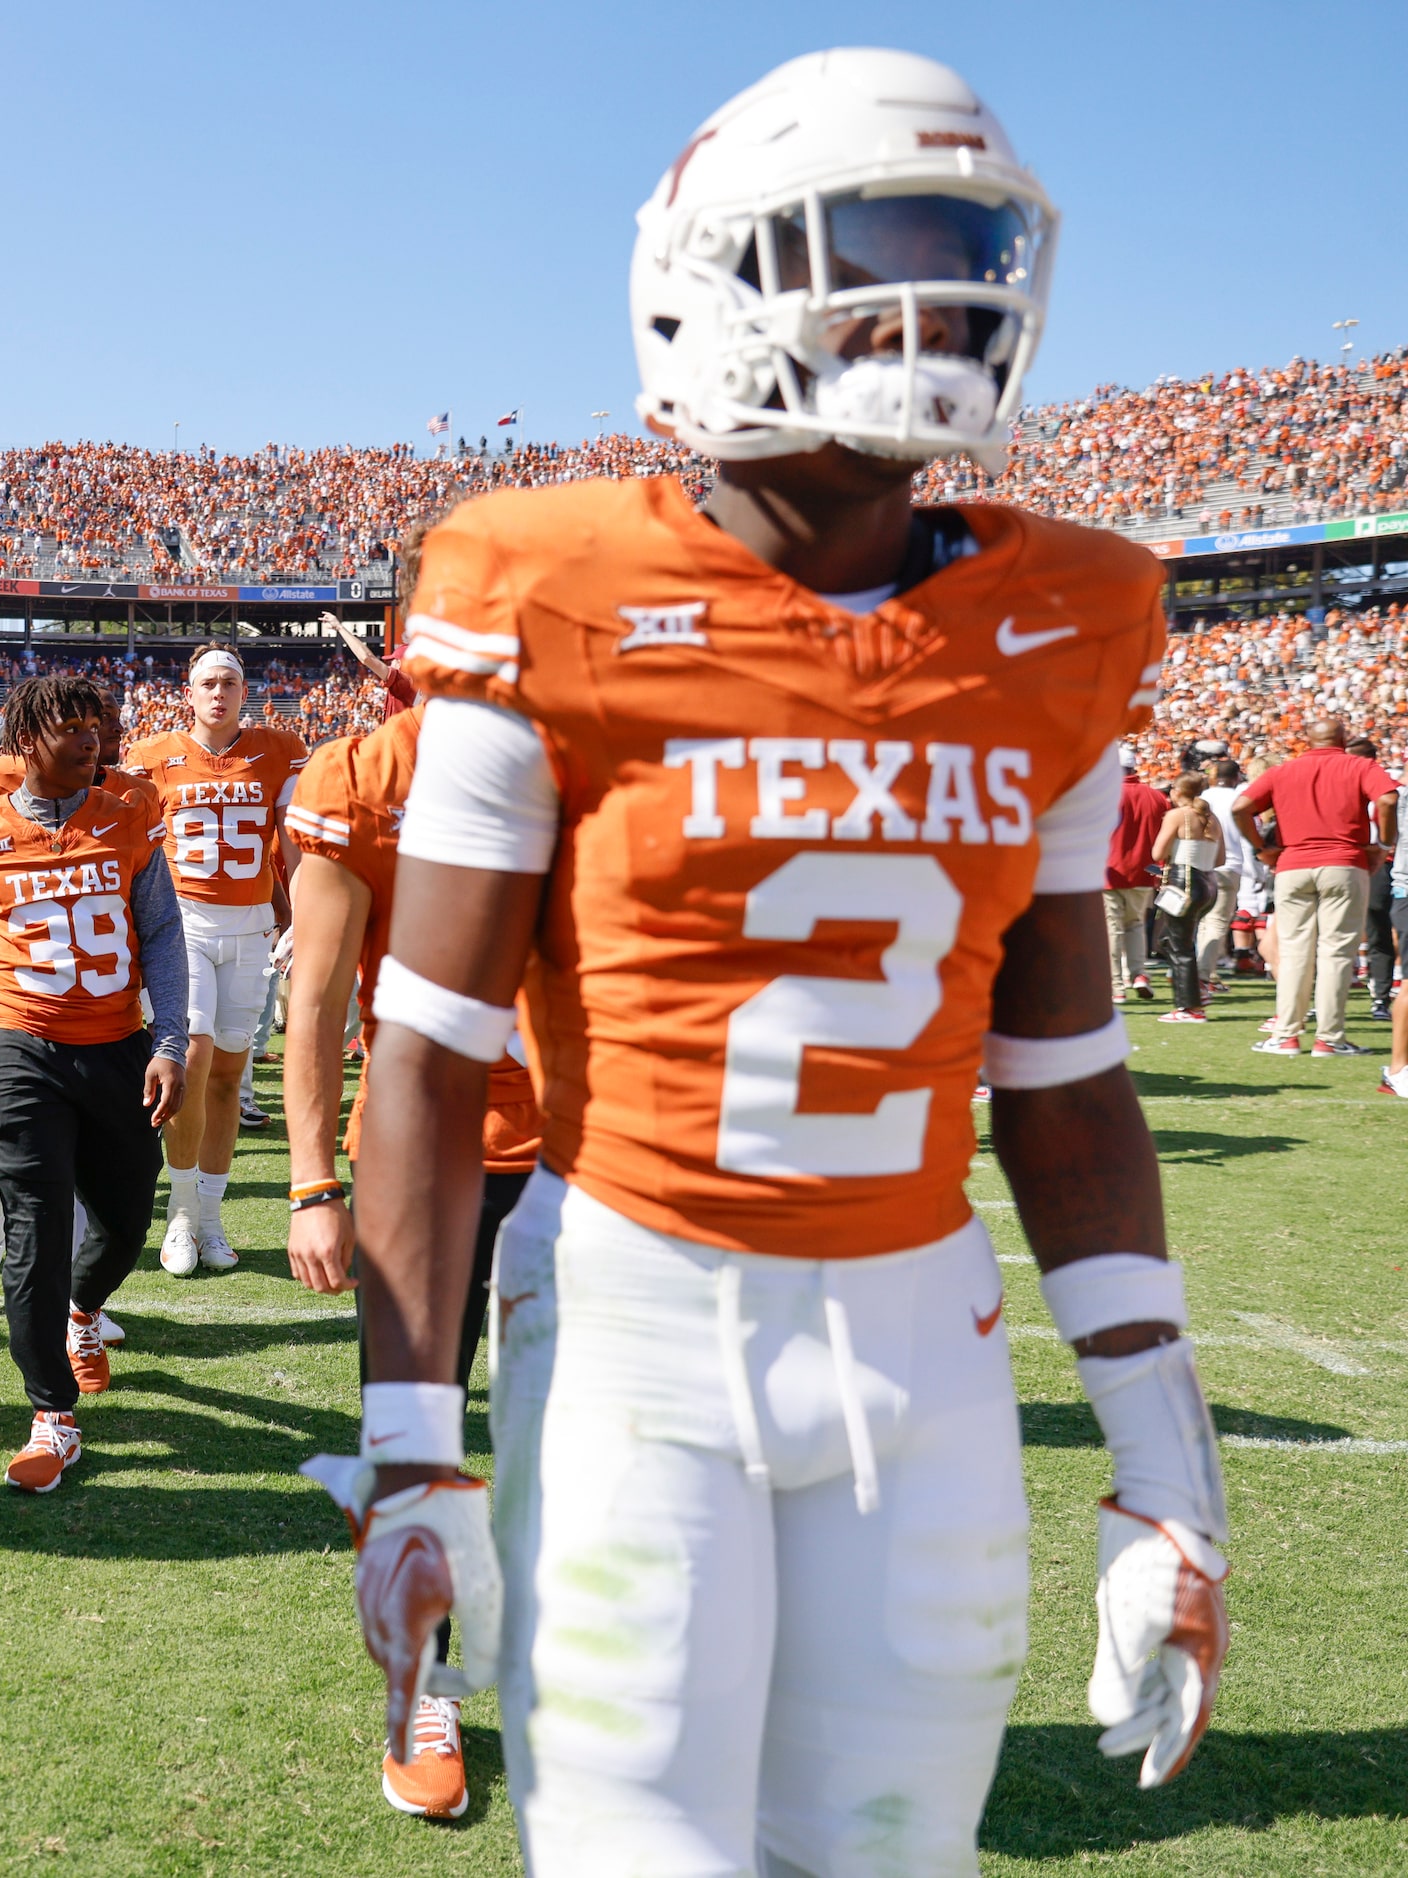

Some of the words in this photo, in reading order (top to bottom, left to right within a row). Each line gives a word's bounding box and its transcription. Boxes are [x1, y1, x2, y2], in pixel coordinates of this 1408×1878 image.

[1237, 531, 1291, 548] Allstate
[160, 588, 186, 598] BANK
[187, 588, 200, 598] OF
[200, 589, 228, 599] TEXAS
[278, 588, 316, 600] Allstate
[176, 781, 264, 806] TEXAS
[663, 736, 1035, 847] TEXAS
[172, 806, 269, 880] 85
[5, 860, 121, 905] TEXAS
[8, 894, 133, 998] 39
[715, 850, 965, 1178] 2
